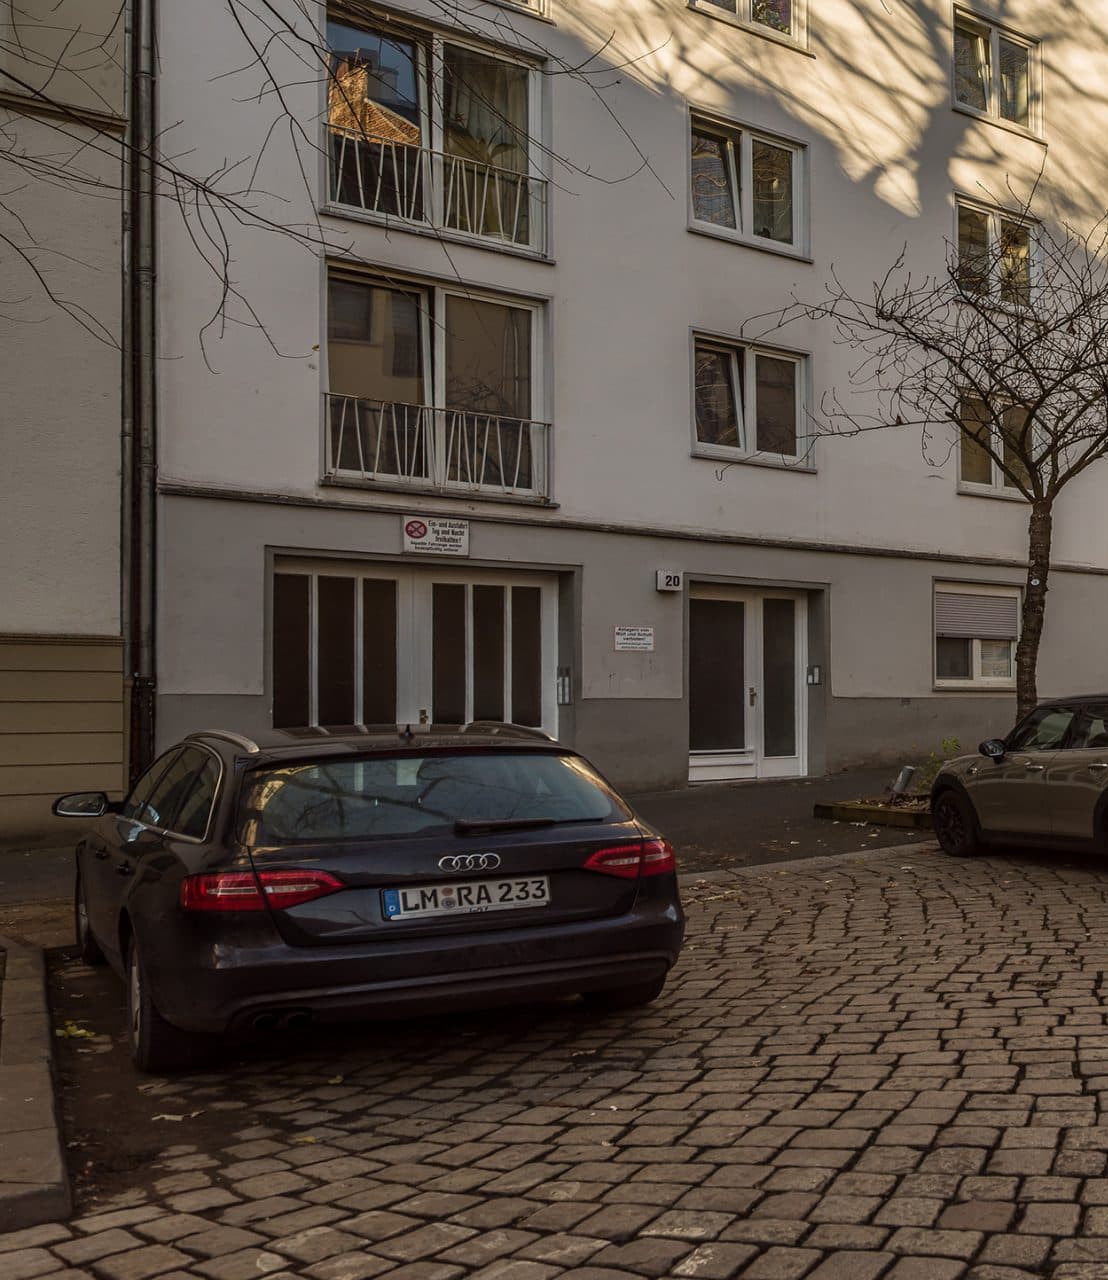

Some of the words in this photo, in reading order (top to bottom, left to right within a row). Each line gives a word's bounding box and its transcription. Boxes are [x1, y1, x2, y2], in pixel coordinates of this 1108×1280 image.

[665, 575, 680, 587] 20
[401, 888, 439, 912] LM
[456, 884, 492, 907] RA
[498, 879, 547, 903] 233
